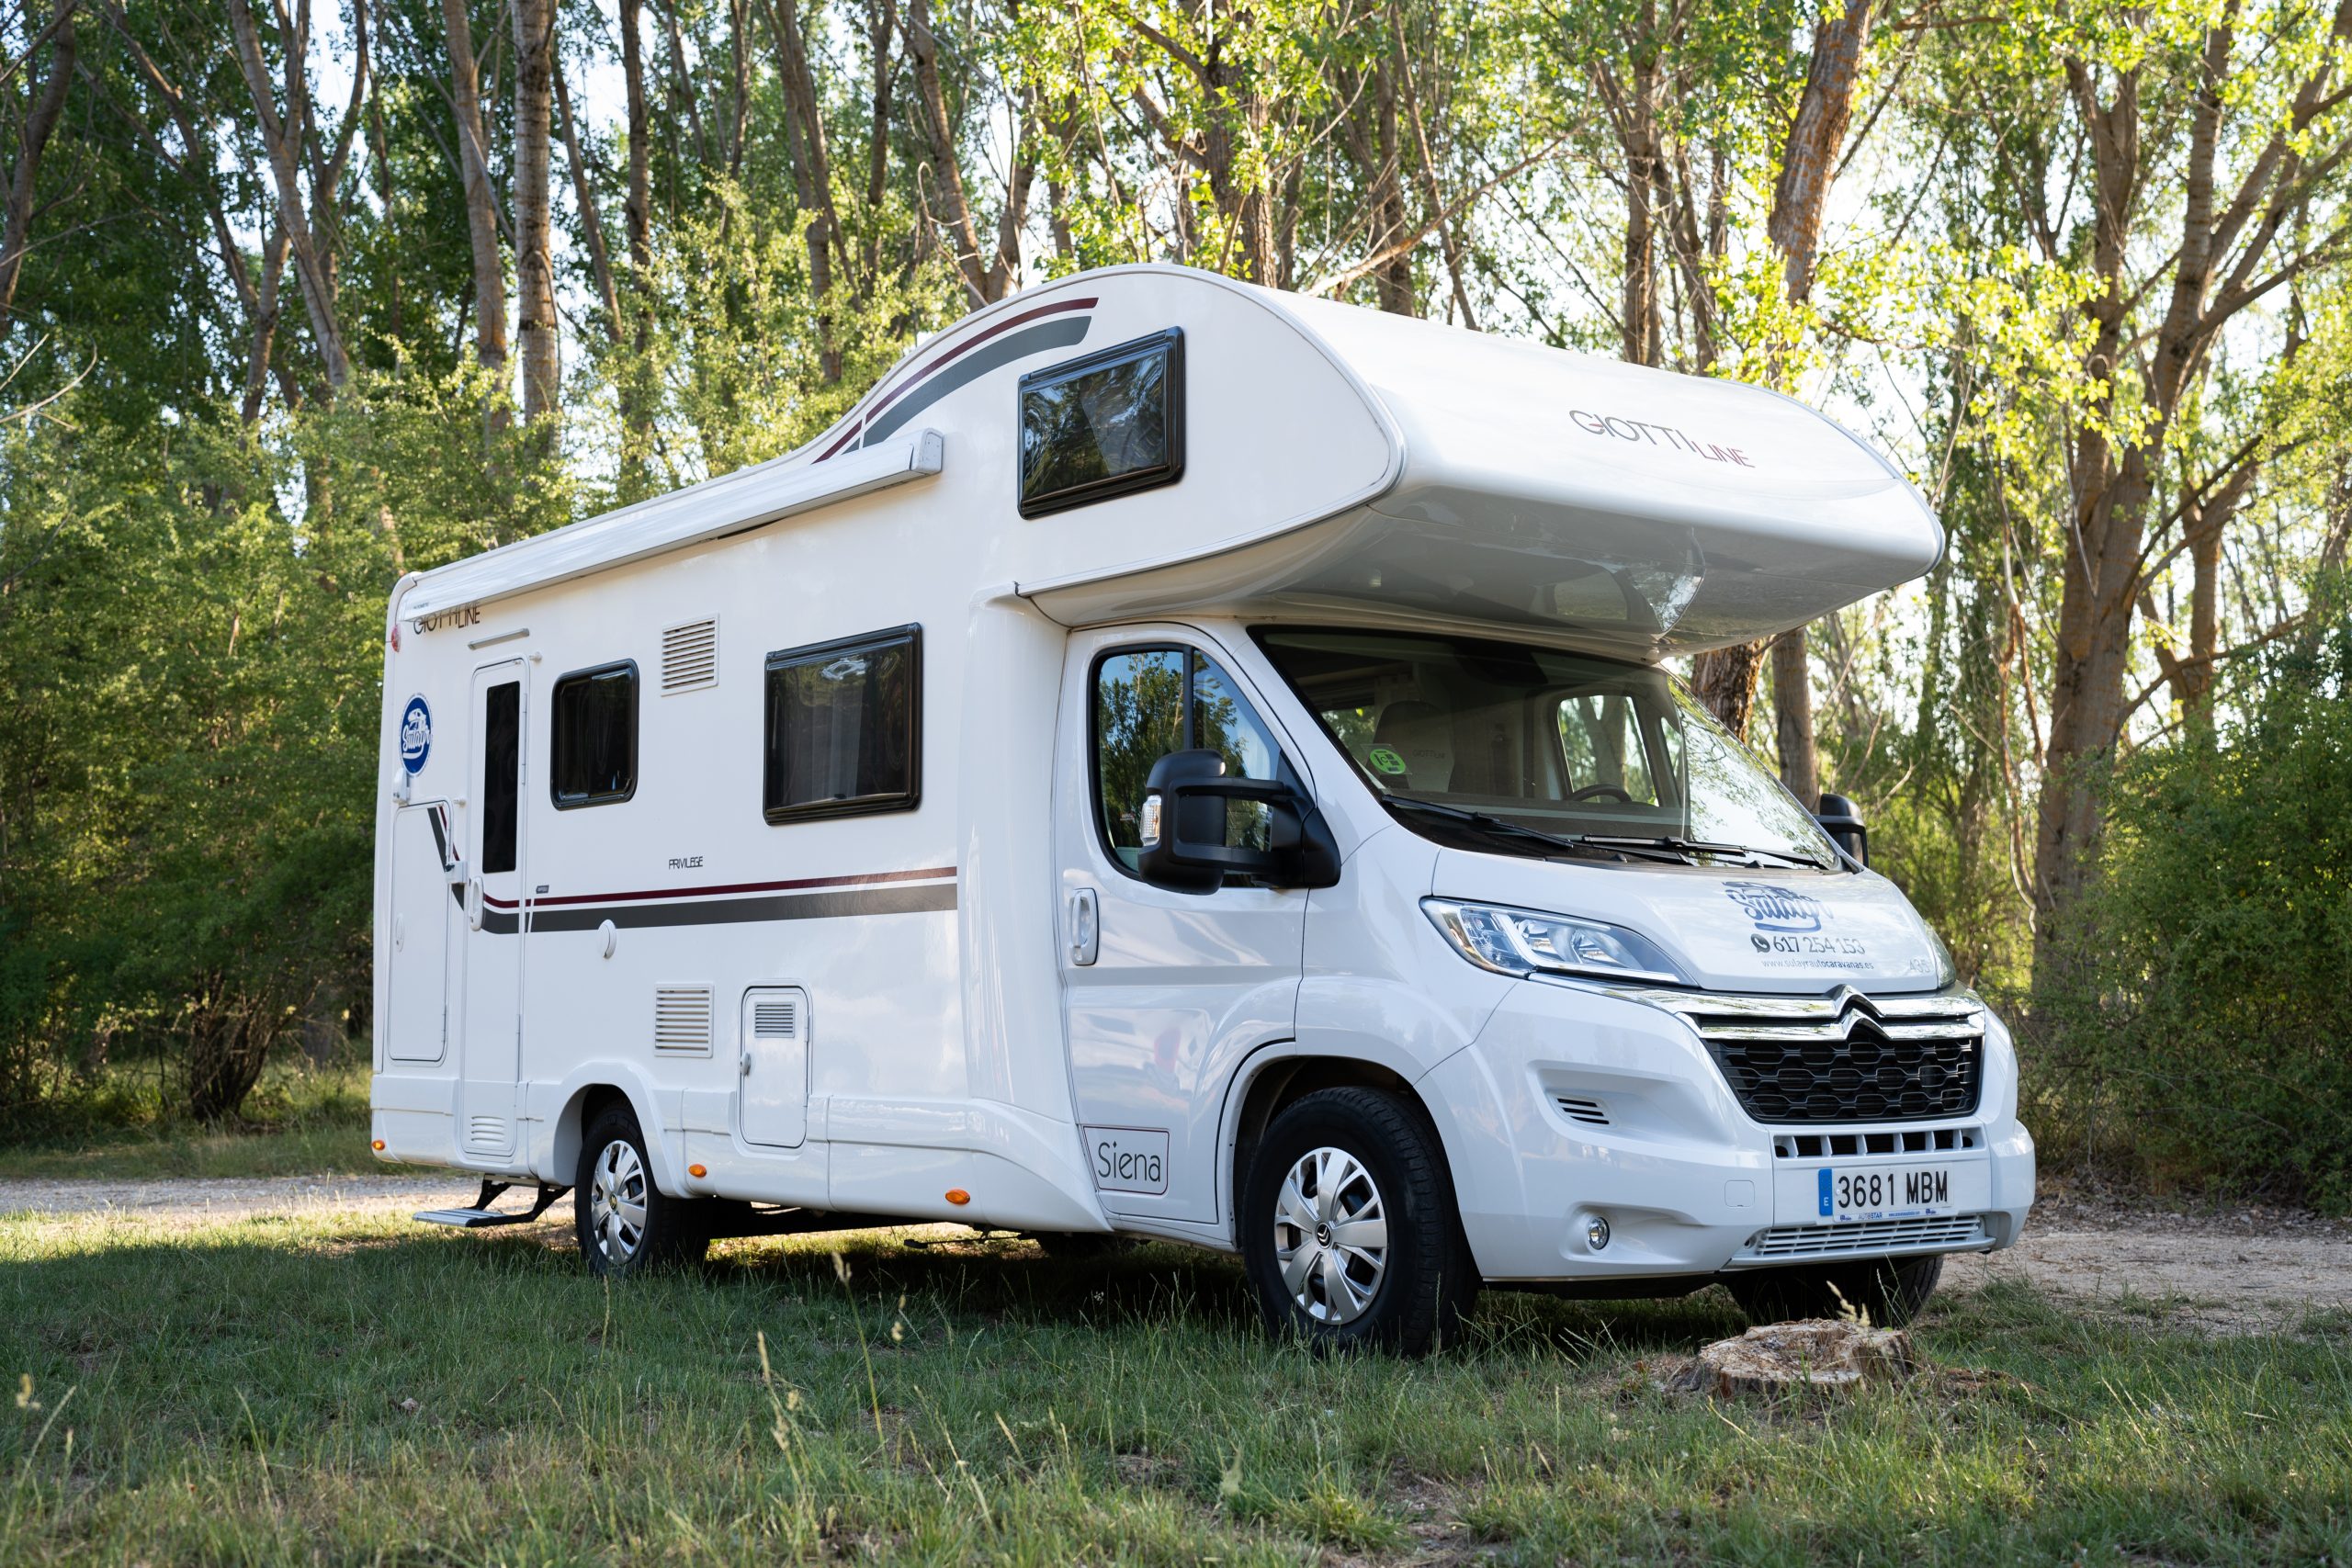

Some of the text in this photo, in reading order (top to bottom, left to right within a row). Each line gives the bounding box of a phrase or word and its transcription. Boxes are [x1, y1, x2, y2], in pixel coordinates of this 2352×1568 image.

[1569, 410, 1756, 468] GIOTTILINE
[669, 856, 703, 870] PRIVILEGE
[1773, 936, 1866, 954] 617 254 153
[1098, 1141, 1160, 1182] Siena
[1824, 1197, 1829, 1207] E
[1838, 1170, 1948, 1208] 3681 MBM
